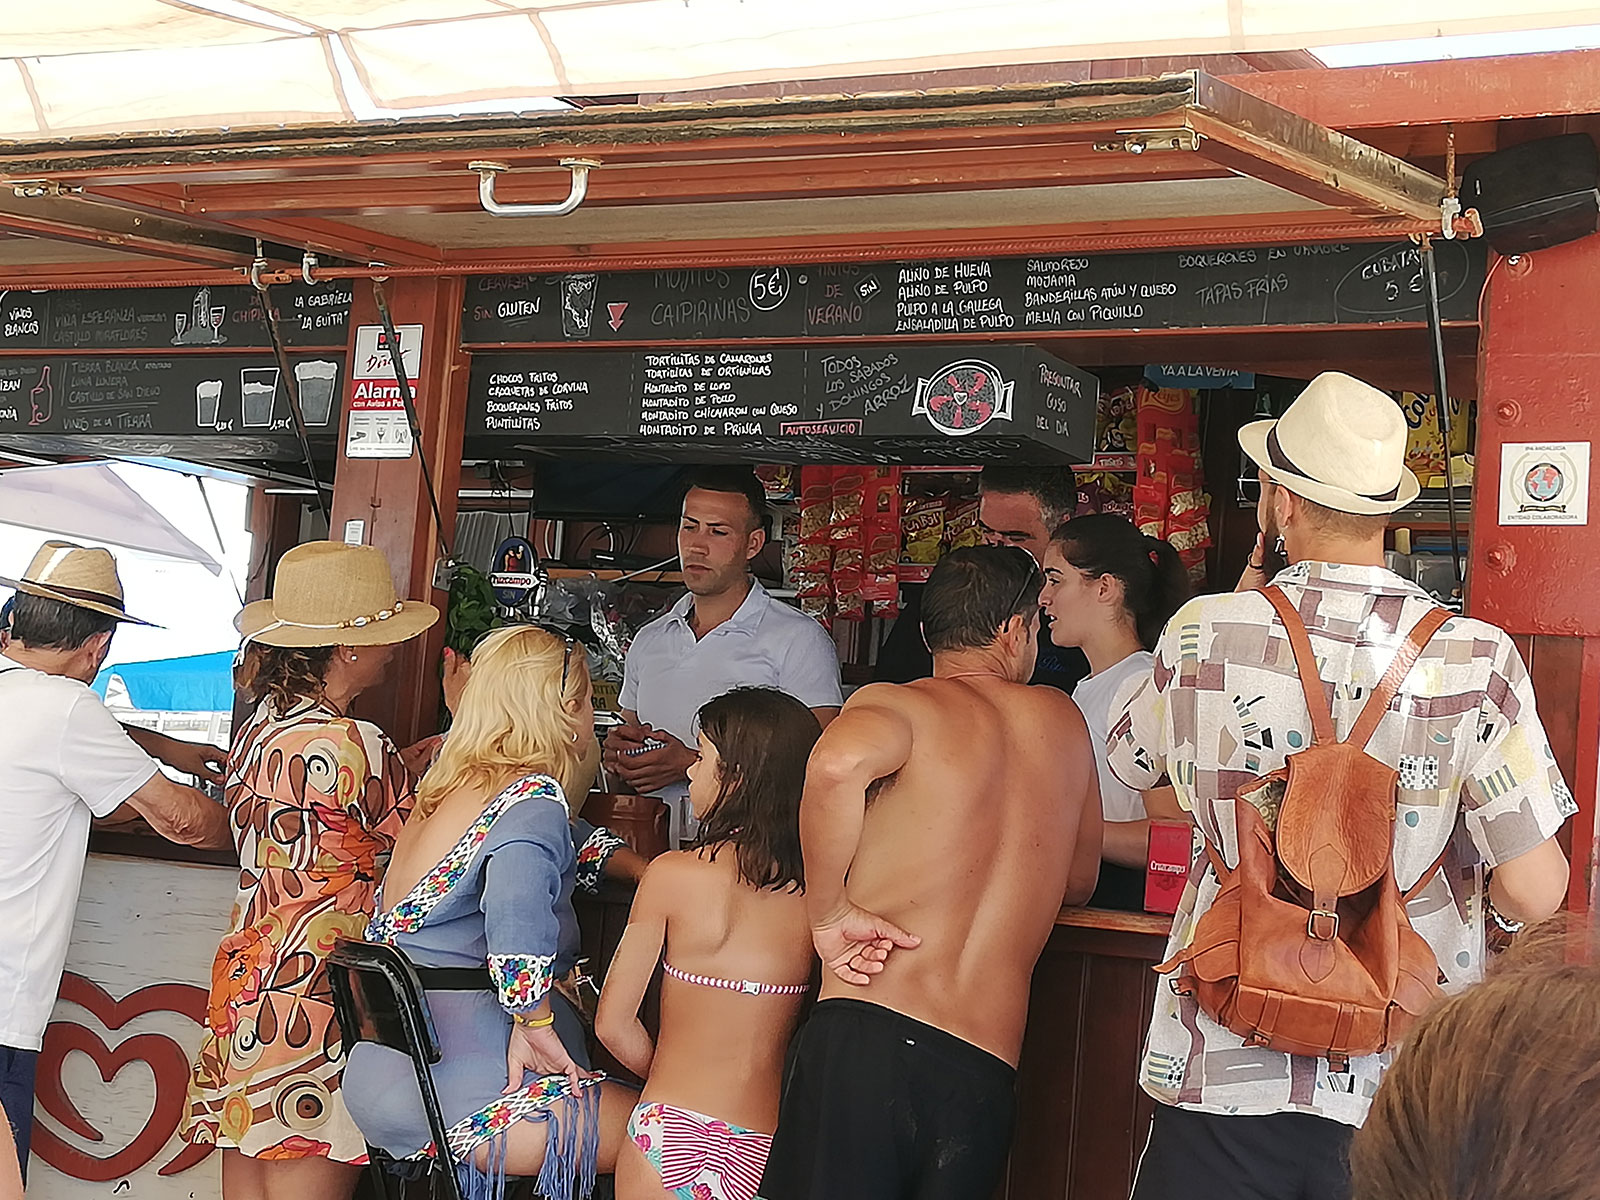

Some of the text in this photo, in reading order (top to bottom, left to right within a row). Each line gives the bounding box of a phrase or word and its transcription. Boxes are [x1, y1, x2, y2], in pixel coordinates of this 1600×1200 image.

[1026, 258, 1089, 272] SALMOREJO
[1178, 249, 1257, 269] BOQUERONES
[1268, 248, 1287, 261] EN
[934, 266, 950, 279] DE
[954, 261, 992, 278] HUEVA
[753, 268, 783, 300] 5€
[860, 280, 879, 298] SIN
[934, 284, 949, 295] DE
[953, 280, 988, 295] PULPO
[1026, 274, 1076, 289] MOJAMA
[294, 290, 353, 308] LA GABRIELA
[825, 284, 843, 299] DE
[1025, 288, 1098, 308] BANDERILLAS
[1129, 283, 1138, 298] Y
[1140, 283, 1177, 298] QUESO
[1195, 282, 1243, 308] TAPAS
[473, 297, 541, 320] SIN GLUTEN
[808, 302, 863, 325] VERANO
[897, 298, 1004, 317] PULPO A LA GALLEGA
[1025, 304, 1144, 325] MELVA CON PIQUILLO
[4, 321, 39, 338] BLANCOS
[895, 314, 1015, 333] ENSALADILLA DE PULPO
[705, 355, 716, 365] DE
[821, 356, 862, 377] TODOS
[490, 371, 559, 385] CHOCOS FRITOS
[701, 367, 713, 377] DE
[1160, 365, 1175, 376] YA
[1187, 365, 1203, 377] LA
[488, 381, 589, 398] CROQUETAS DE CORVINA
[644, 382, 688, 394] MONTADITO
[694, 382, 706, 391] DE
[826, 379, 846, 394] LOS
[829, 373, 892, 412] DOMINGOS
[864, 374, 915, 416] ARROZ
[487, 399, 574, 414] BOQUERONES FRITOS
[642, 394, 736, 408] MONTADITO DE POLLO
[117, 412, 152, 429] TIERRA
[641, 411, 688, 421] MONTADITO
[752, 407, 766, 416] CON
[769, 403, 798, 416] QUESO
[485, 416, 541, 431] PUNTILLITAS
[640, 423, 698, 436] MONTADITO
[704, 426, 717, 435] DE
[785, 423, 856, 436] AUTOSERVICIO
